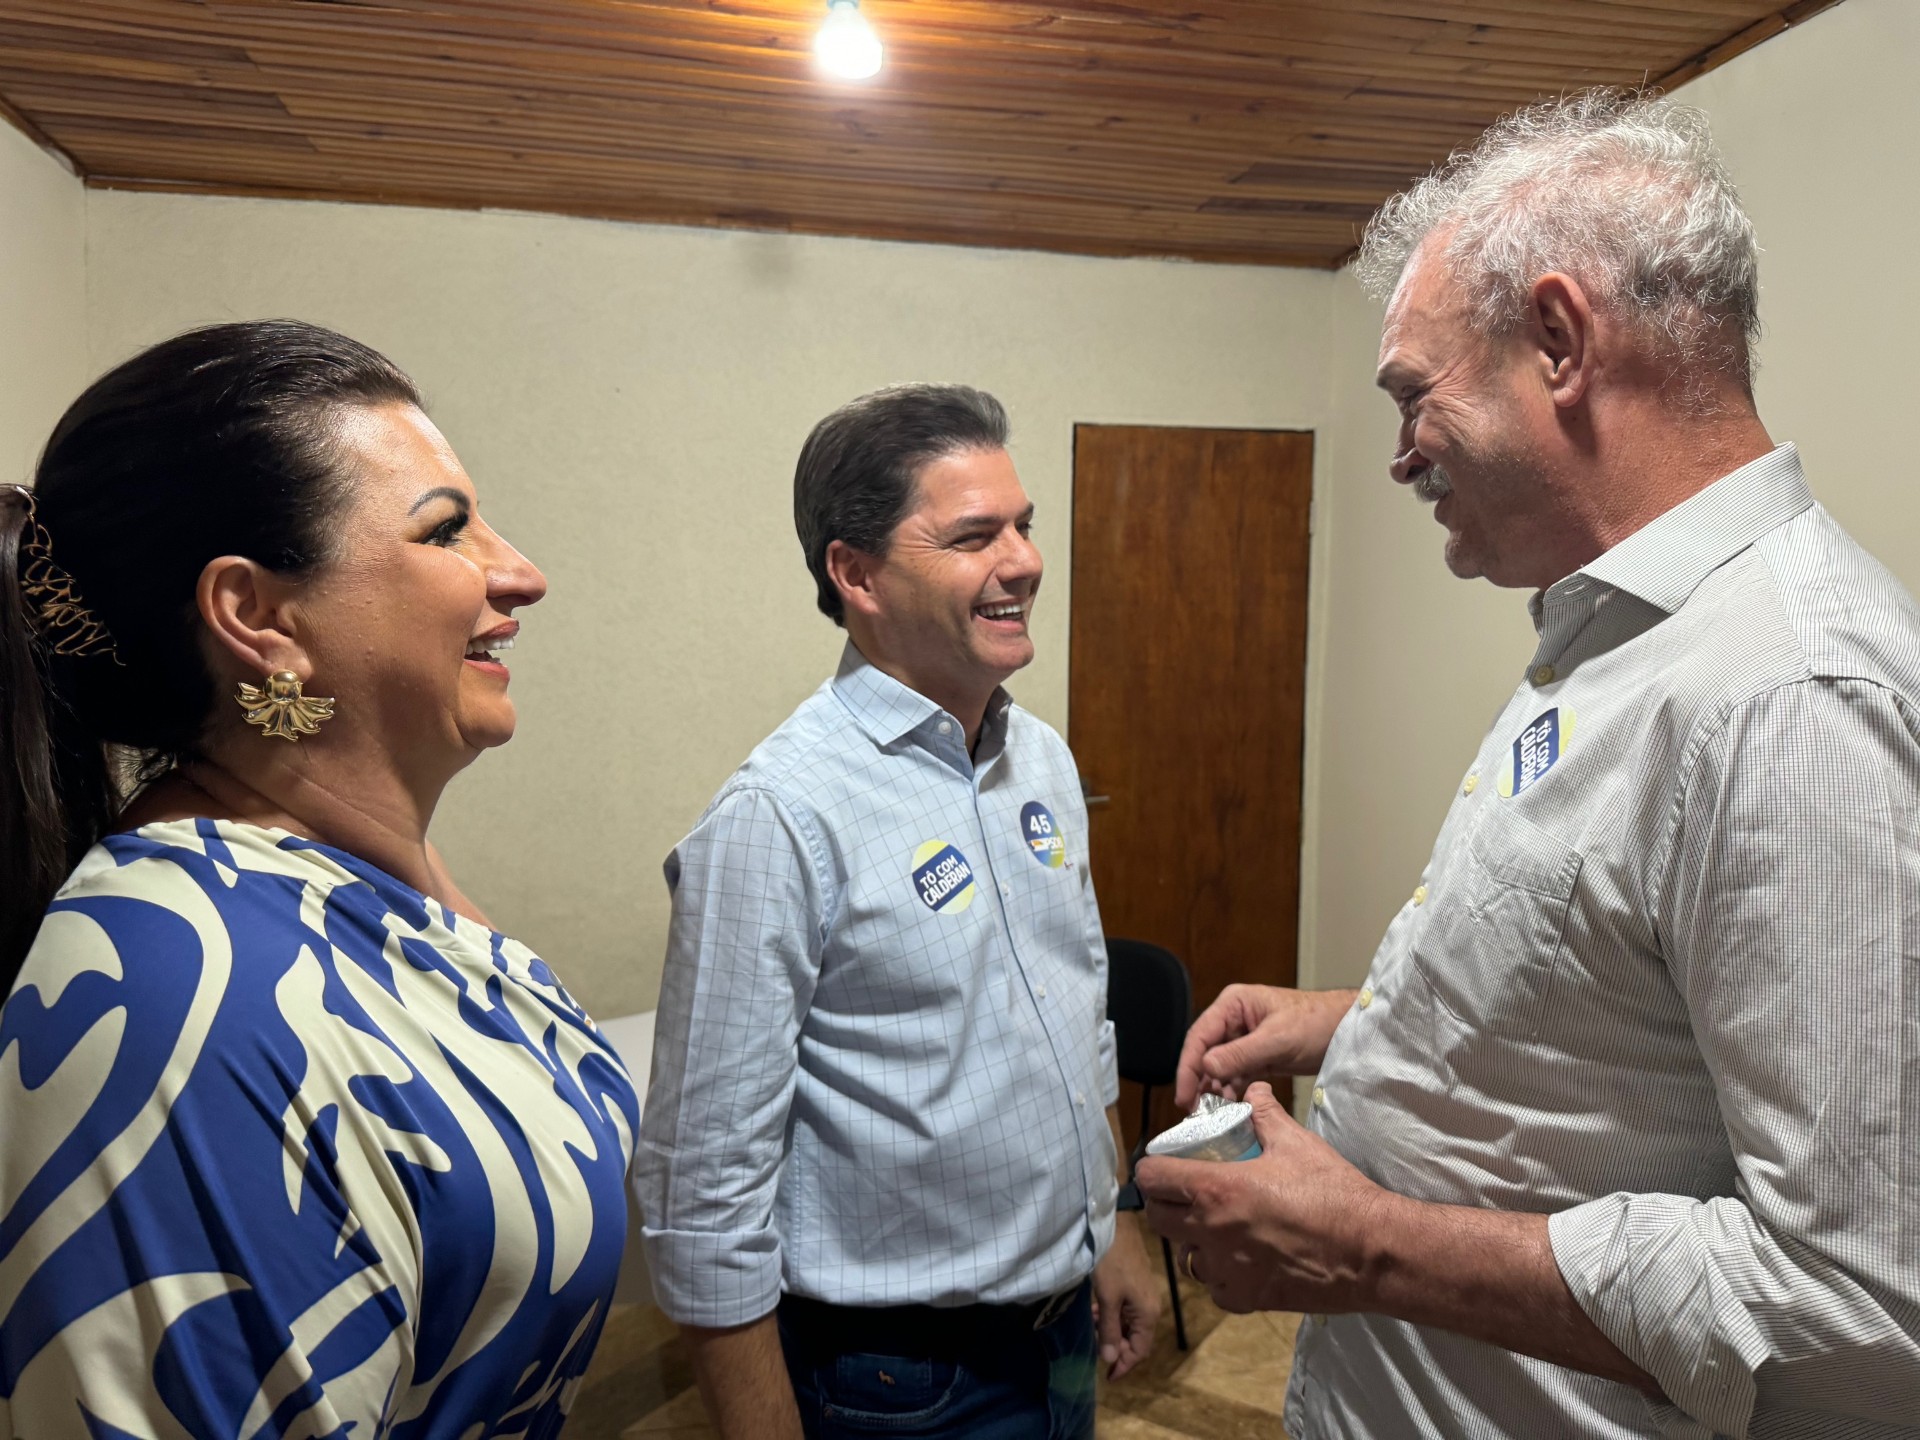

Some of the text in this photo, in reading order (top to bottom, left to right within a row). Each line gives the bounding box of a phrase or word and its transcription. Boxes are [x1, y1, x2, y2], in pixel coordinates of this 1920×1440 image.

[1518, 726, 1537, 793] CALDERAN
[1536, 741, 1550, 774] COM
[1030, 815, 1052, 835] 45
[935, 854, 959, 877] COM
[923, 861, 971, 906] CALDERAN
